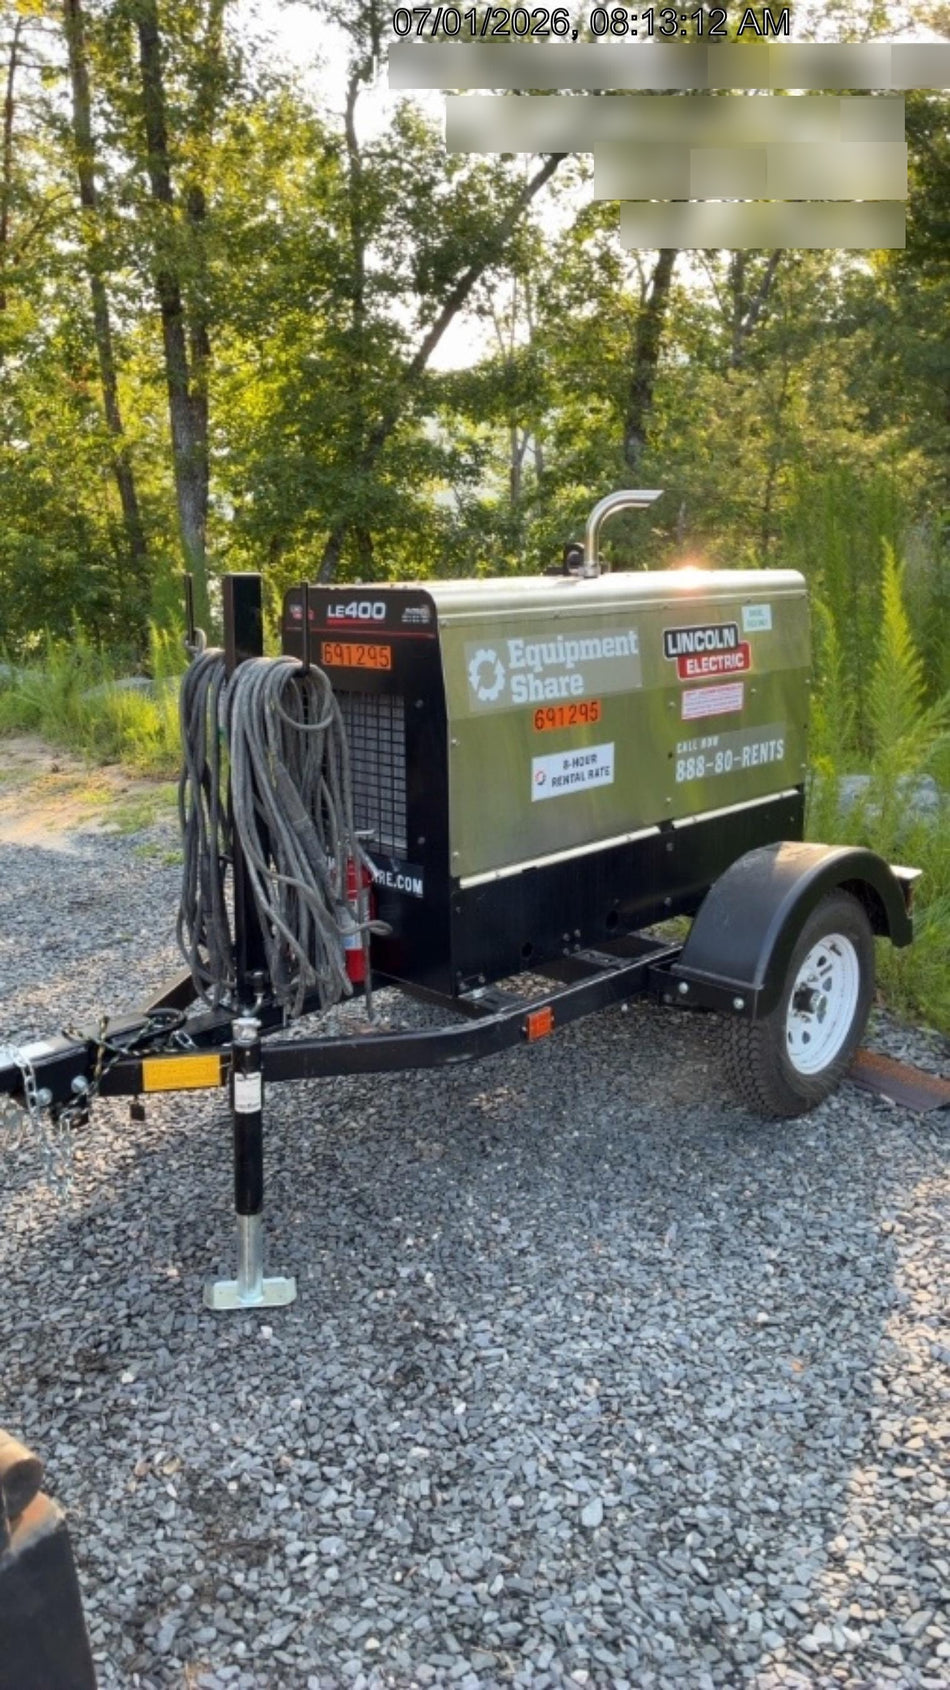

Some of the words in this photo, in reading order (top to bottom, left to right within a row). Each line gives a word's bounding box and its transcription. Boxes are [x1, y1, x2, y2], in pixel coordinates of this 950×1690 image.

[328, 602, 386, 619] LE400
[507, 630, 639, 673] Equipment
[667, 627, 736, 655] LINCOLN
[324, 643, 390, 668] 691295
[686, 653, 745, 675] ELECTRIC
[510, 673, 585, 703] Share
[534, 701, 600, 731] 691295
[562, 754, 598, 770] 8-HOUR
[676, 739, 784, 782] 888-80-RENTS
[551, 771, 586, 788] RENTAL
[587, 766, 611, 779] RATE
